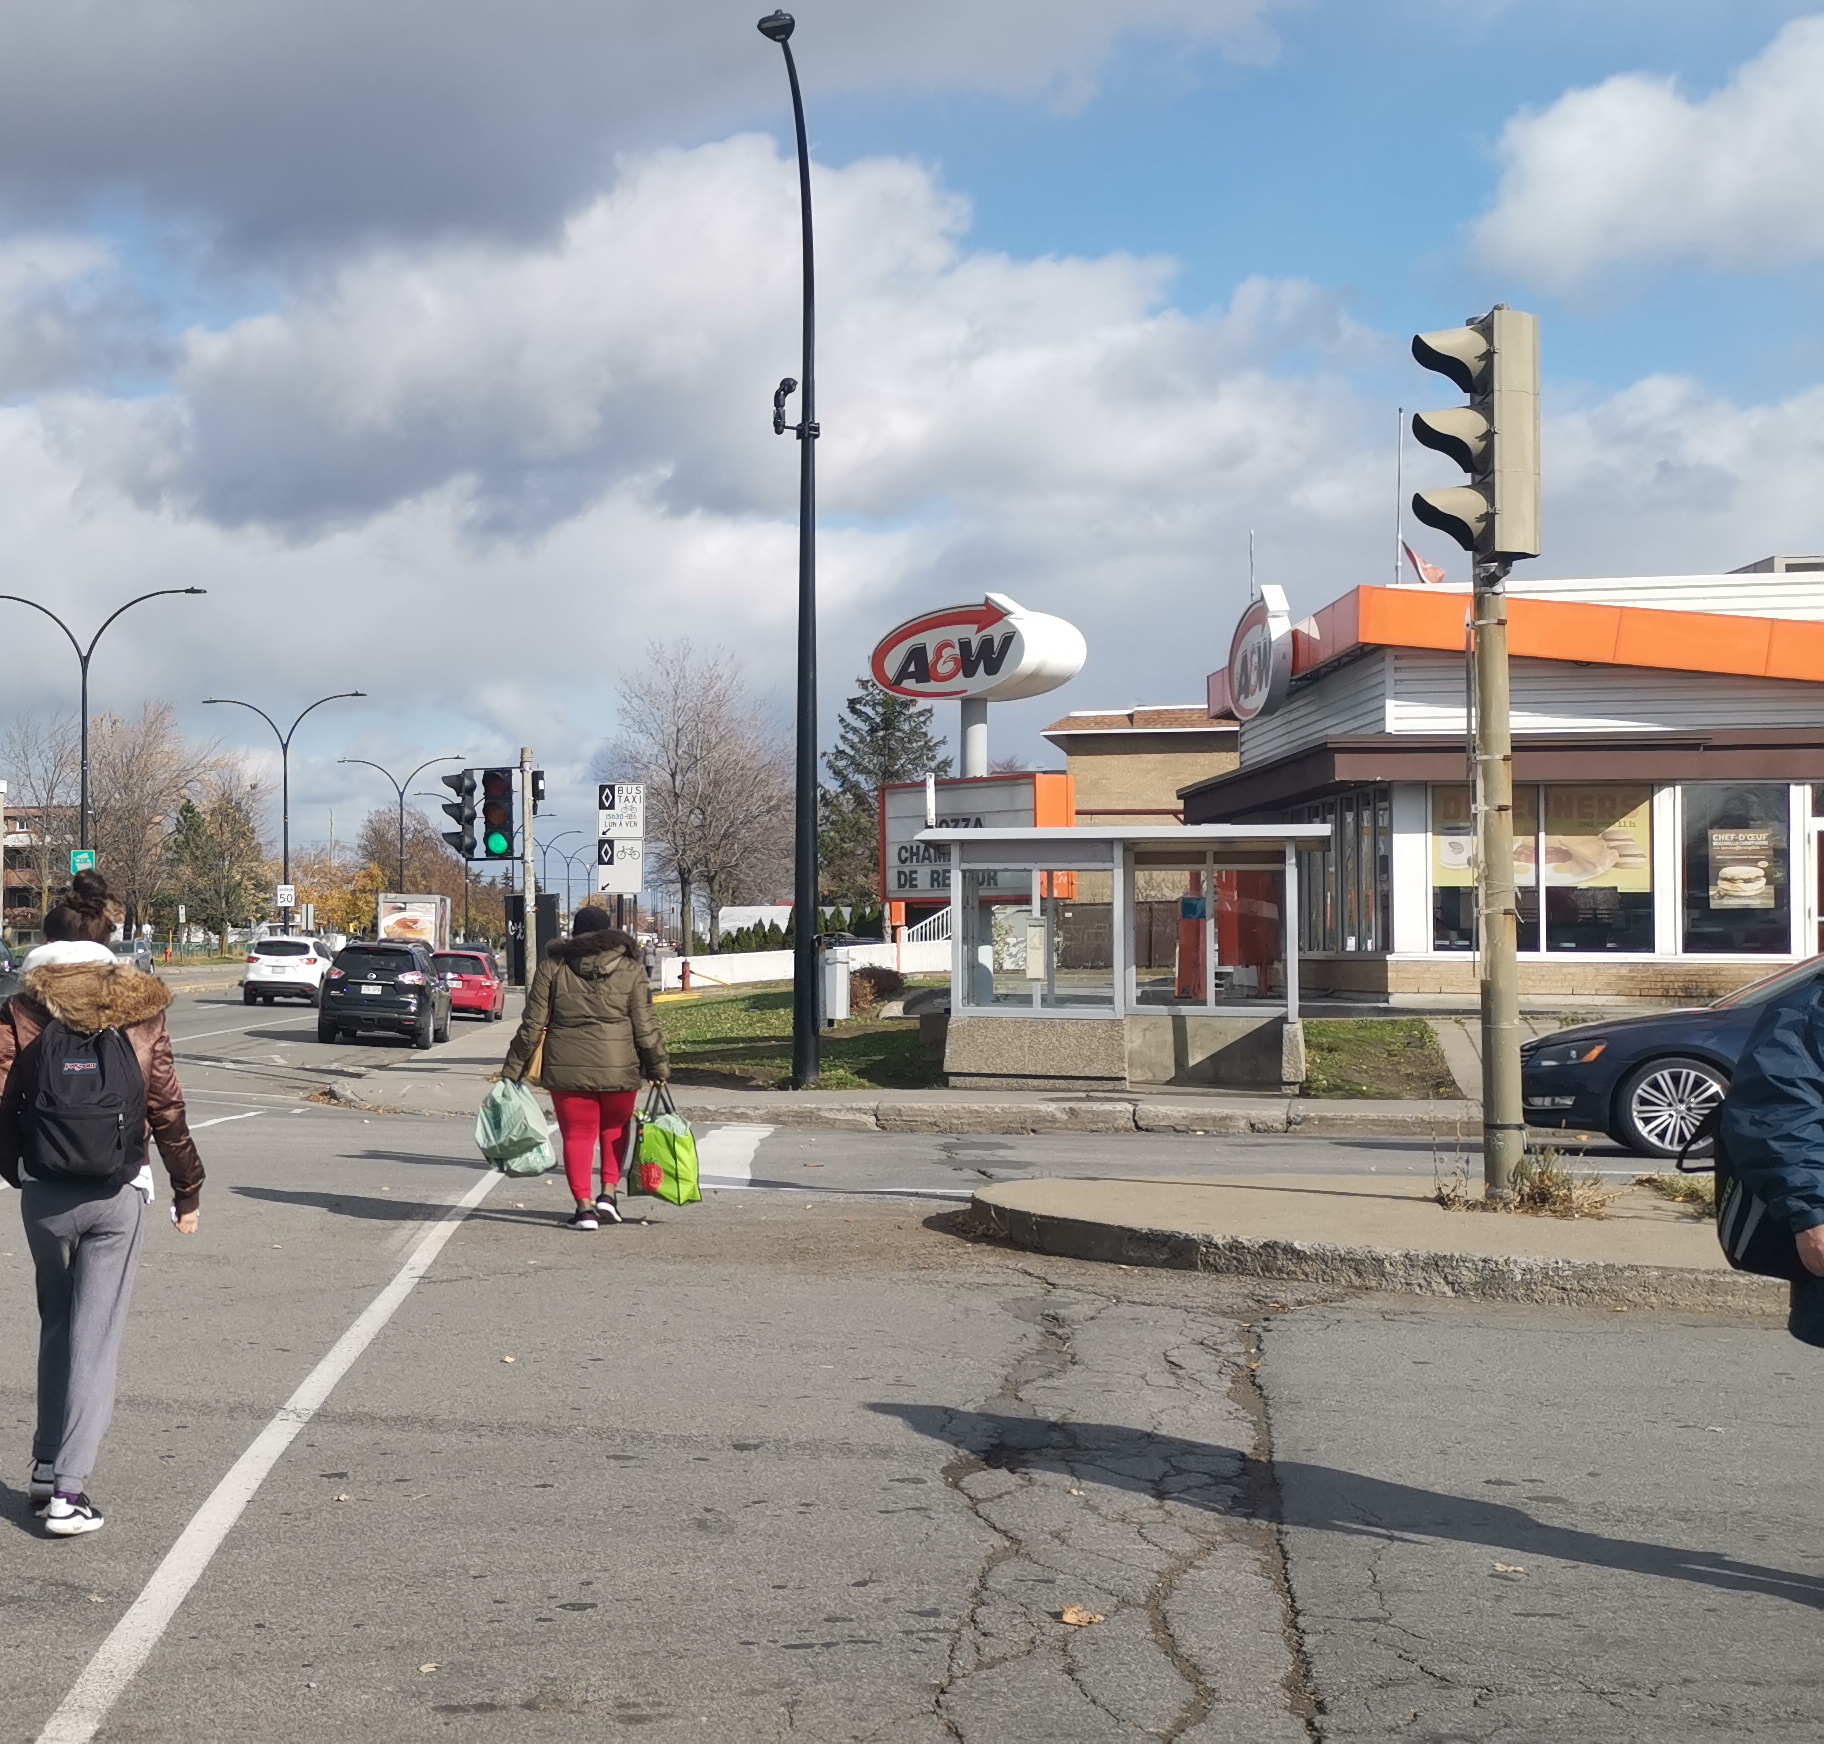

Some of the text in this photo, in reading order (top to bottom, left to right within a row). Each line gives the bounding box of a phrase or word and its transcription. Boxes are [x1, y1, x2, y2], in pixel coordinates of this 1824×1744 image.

[890, 631, 1017, 687] A&W
[1237, 632, 1272, 701] A&W
[618, 786, 641, 794] BUS
[618, 795, 641, 803] TAXI
[897, 869, 919, 889] DE
[279, 893, 293, 904] 50
